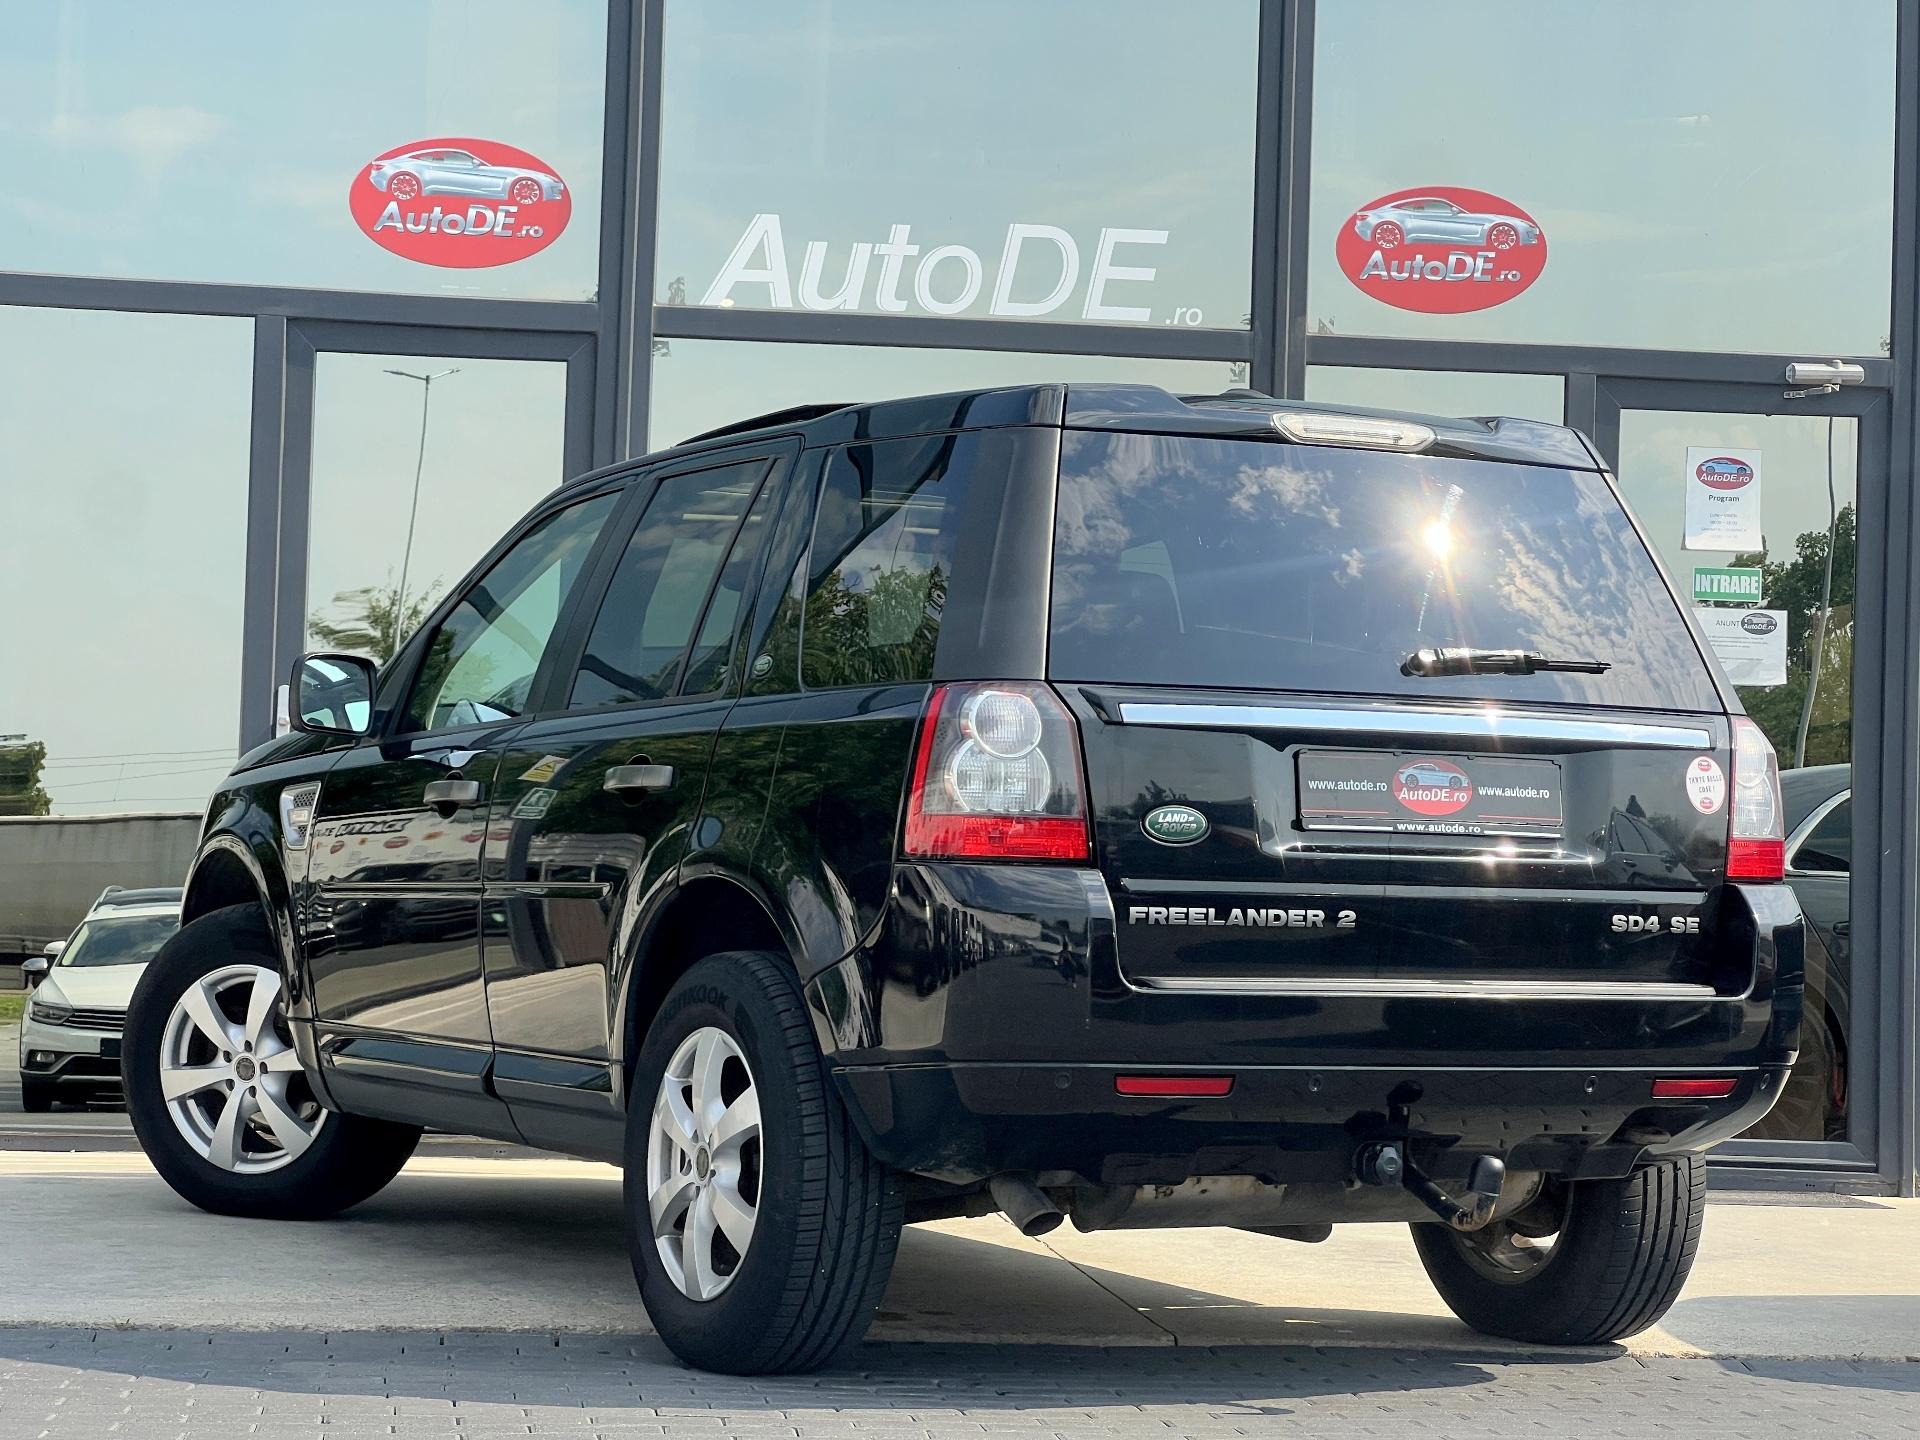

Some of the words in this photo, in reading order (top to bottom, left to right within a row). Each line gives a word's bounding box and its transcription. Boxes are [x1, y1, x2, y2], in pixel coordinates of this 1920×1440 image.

[1700, 473, 1750, 483] AutoDE.ro
[1708, 494, 1740, 502] Program
[1695, 574, 1759, 594] INTRARE
[1743, 622, 1775, 631] AutoDE.ro
[1308, 778, 1388, 792] www.autode.ro
[1478, 784, 1550, 799] www.autode.ro
[1399, 786, 1468, 803] AutoDE.ro
[1158, 812, 1188, 823] LAND
[1162, 823, 1197, 833] ROVER
[1396, 822, 1481, 834] www.autode.ro
[1128, 906, 1325, 928] FREELANDER
[1336, 910, 1357, 928] 2
[1611, 914, 1660, 933] SD4
[1670, 916, 1700, 934] SE
